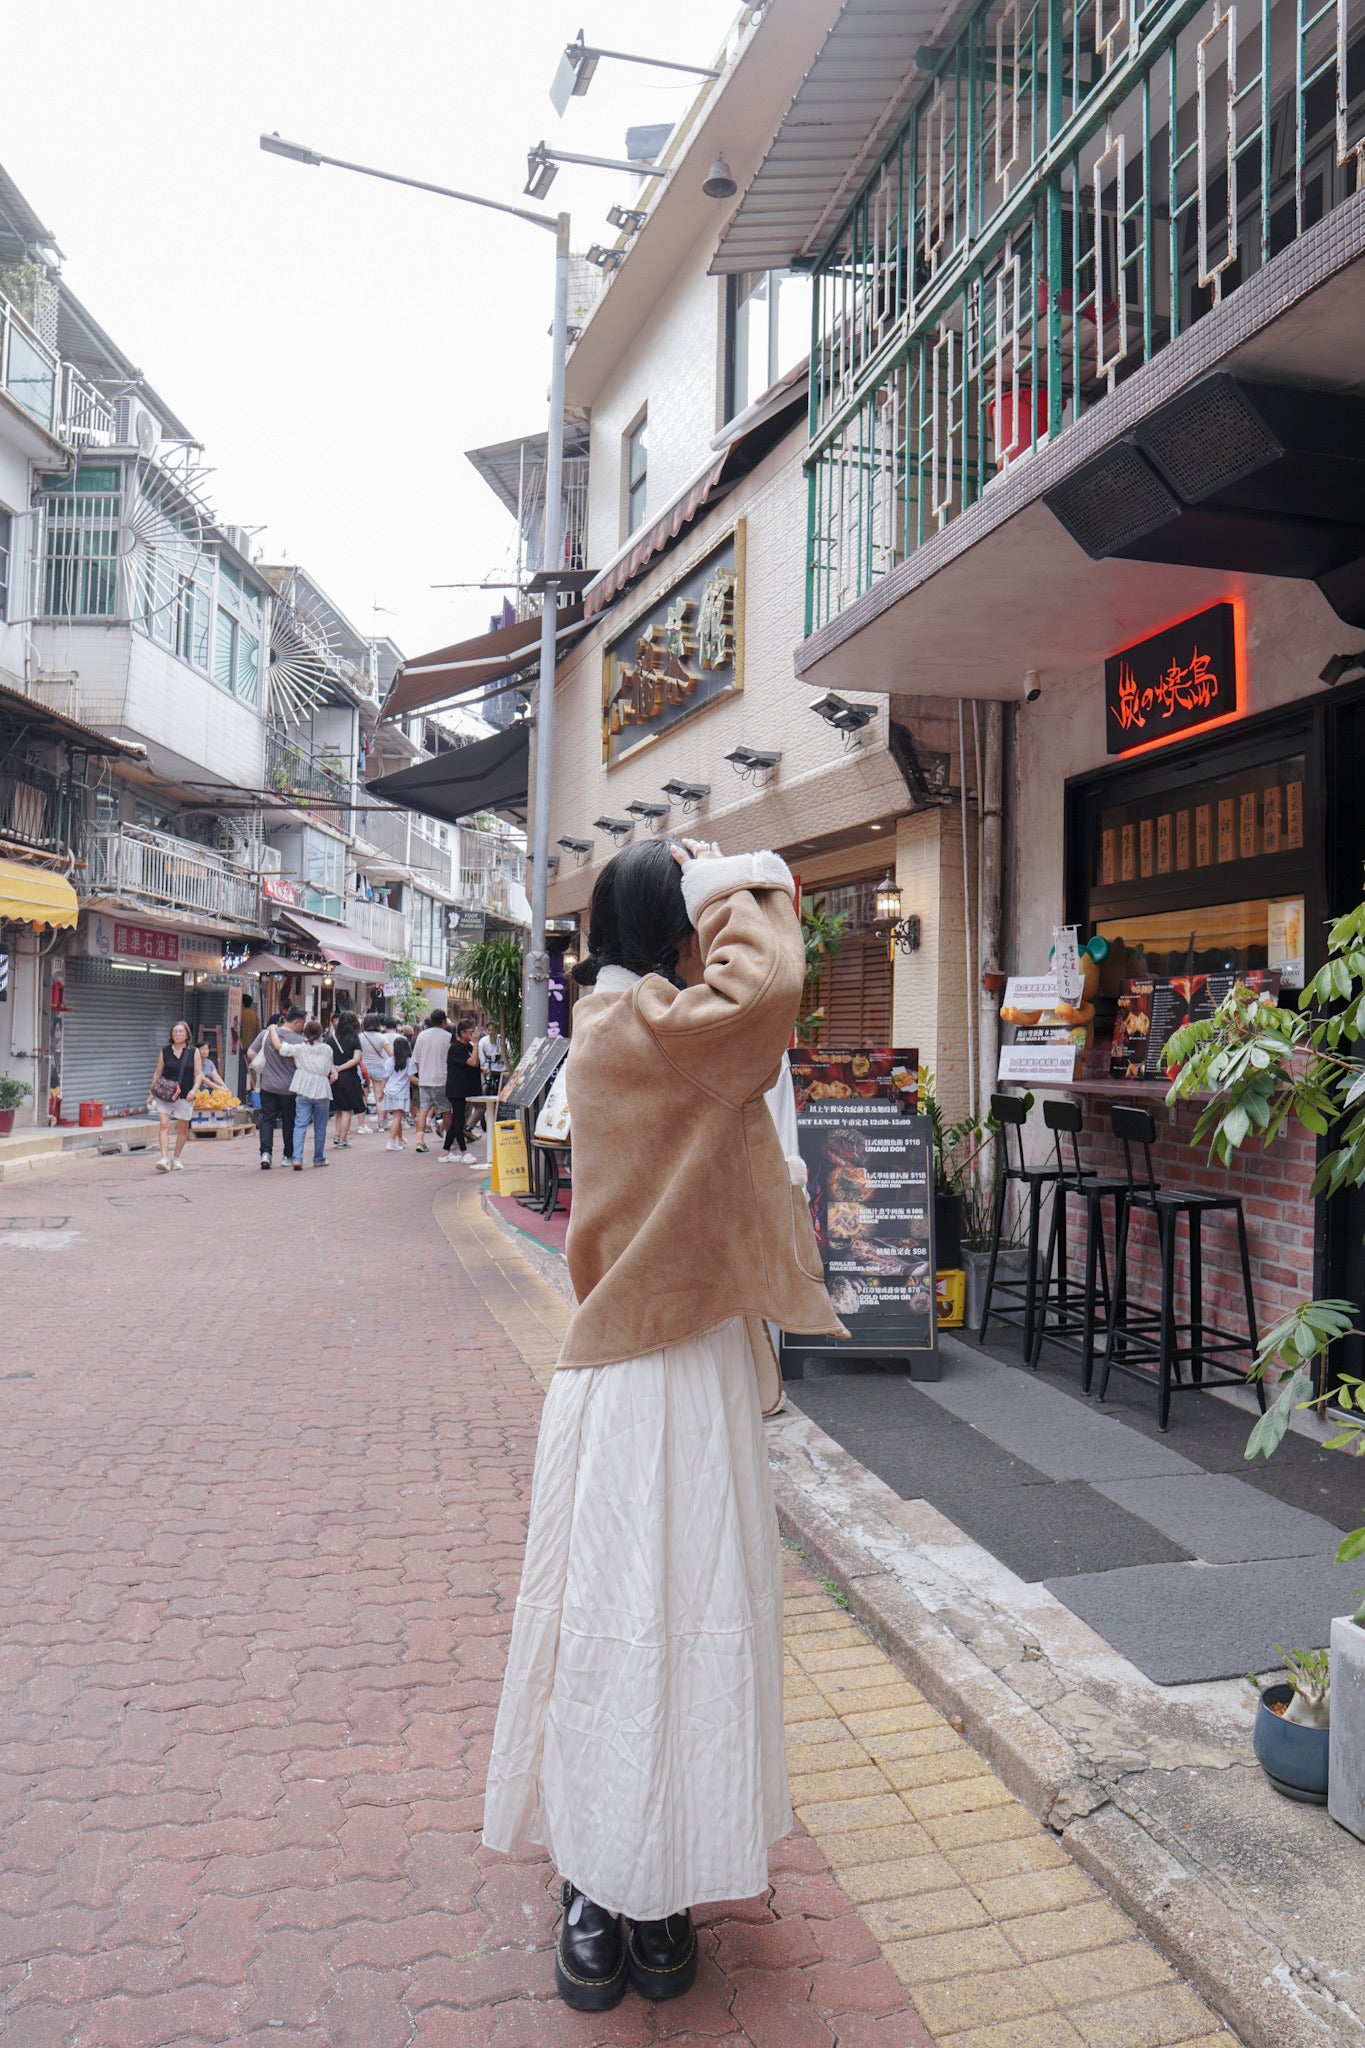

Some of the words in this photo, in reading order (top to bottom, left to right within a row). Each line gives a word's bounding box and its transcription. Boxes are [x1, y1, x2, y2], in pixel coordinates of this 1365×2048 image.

[116, 926, 177, 958] 標準石油氣
[1062, 952, 1070, 995] てんこもり
[505, 1166, 526, 1176] 小心地滑
[912, 1248, 926, 1256] $98
